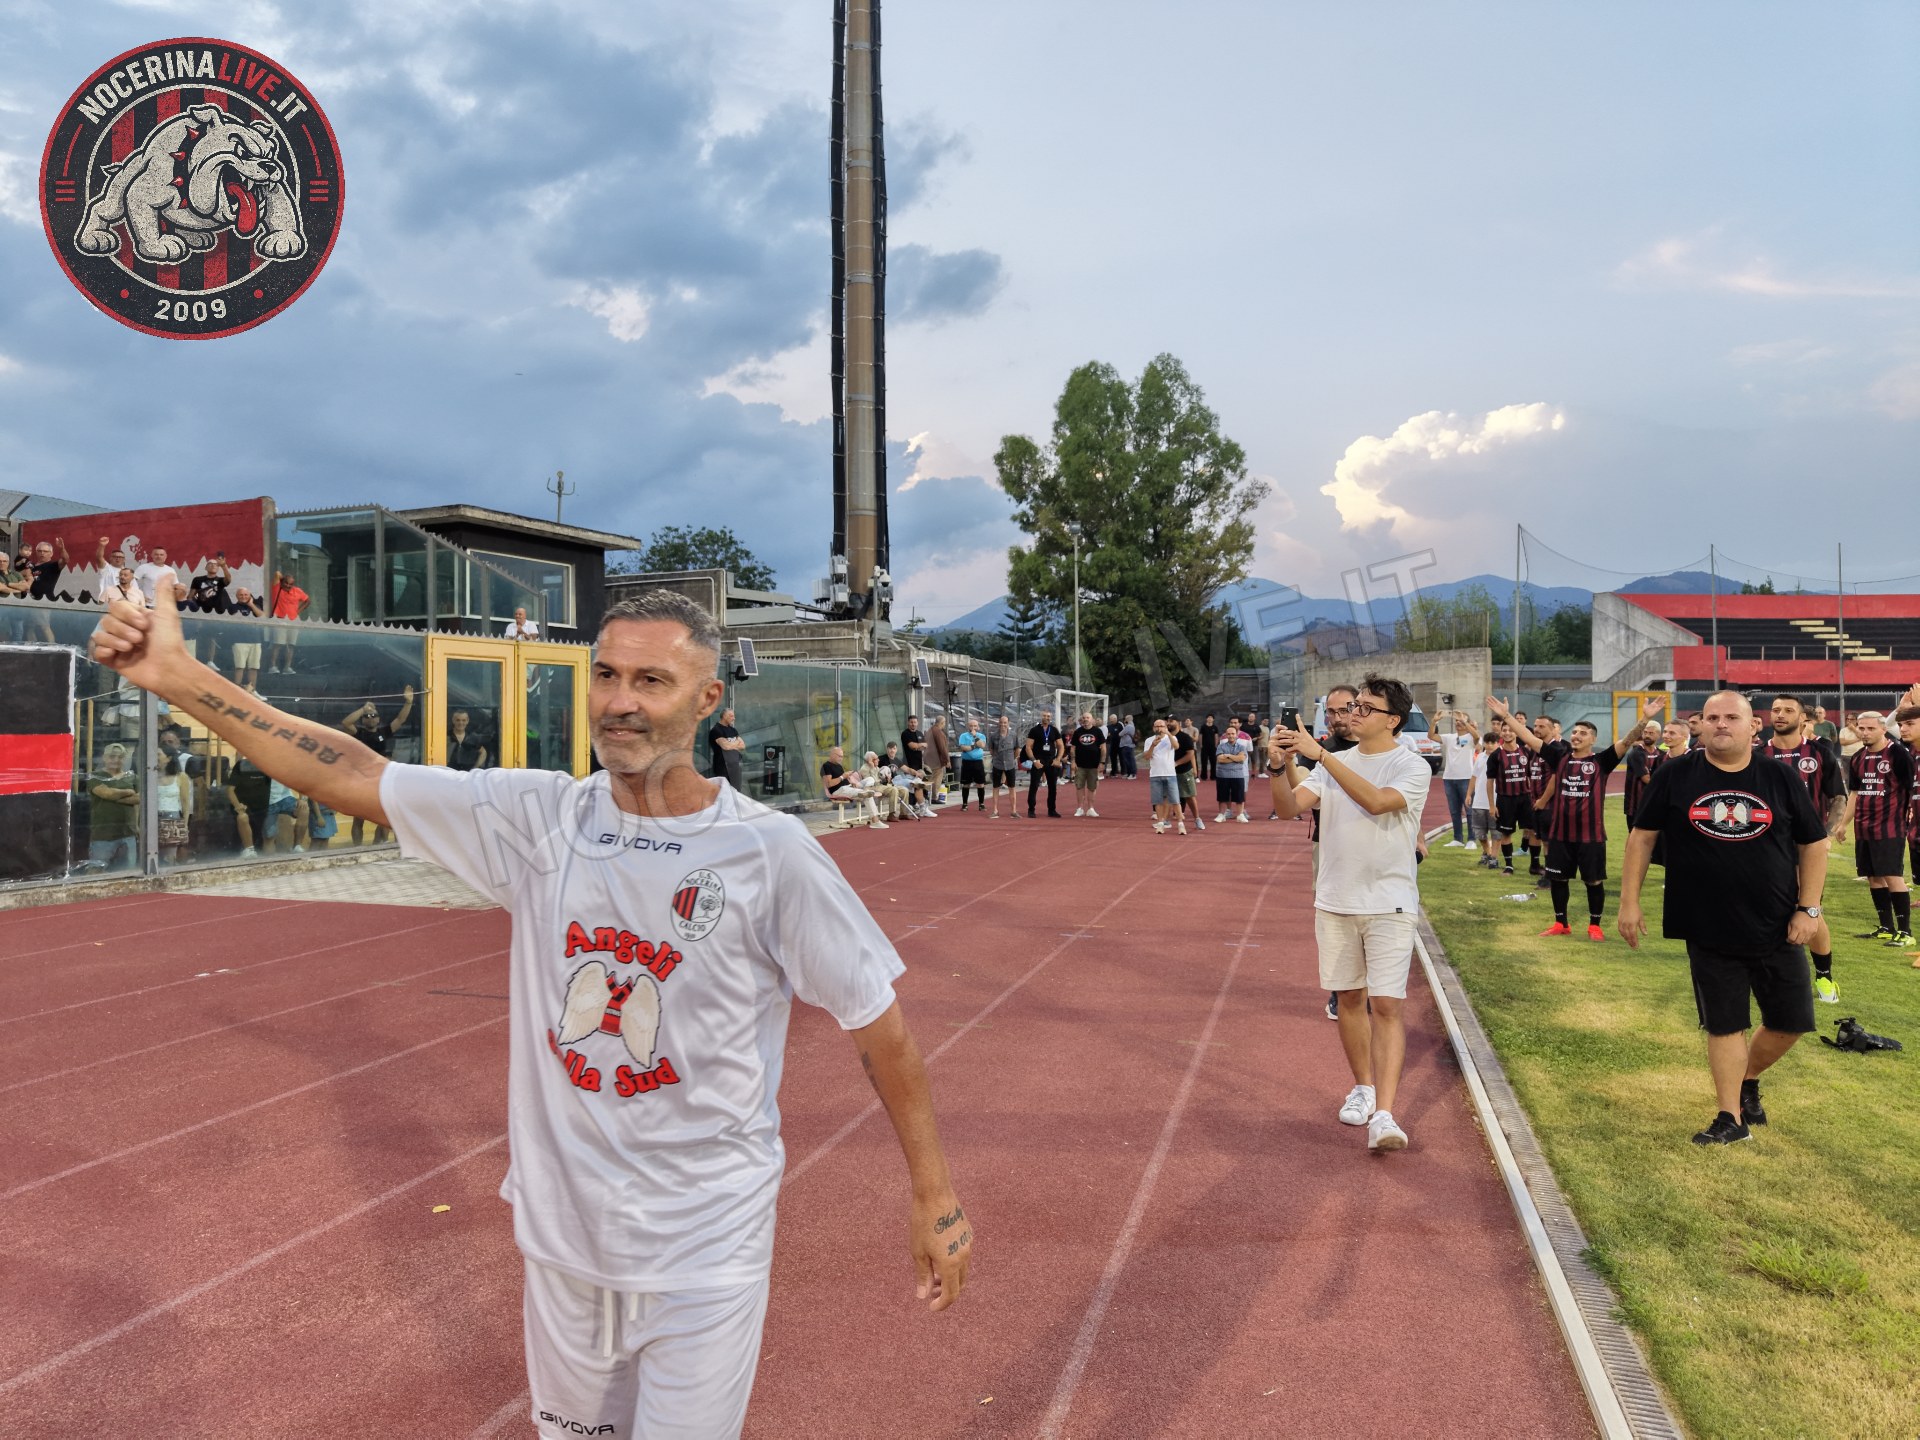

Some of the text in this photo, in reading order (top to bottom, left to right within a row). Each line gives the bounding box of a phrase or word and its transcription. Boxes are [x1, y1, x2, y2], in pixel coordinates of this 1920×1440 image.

[599, 833, 682, 855] GIVOVA
[686, 877, 722, 893] NOCERINA
[678, 920, 706, 932] CALCIO
[565, 921, 683, 982] Angeli
[615, 1057, 680, 1097] Sud
[540, 1411, 615, 1436] GIVOVA
